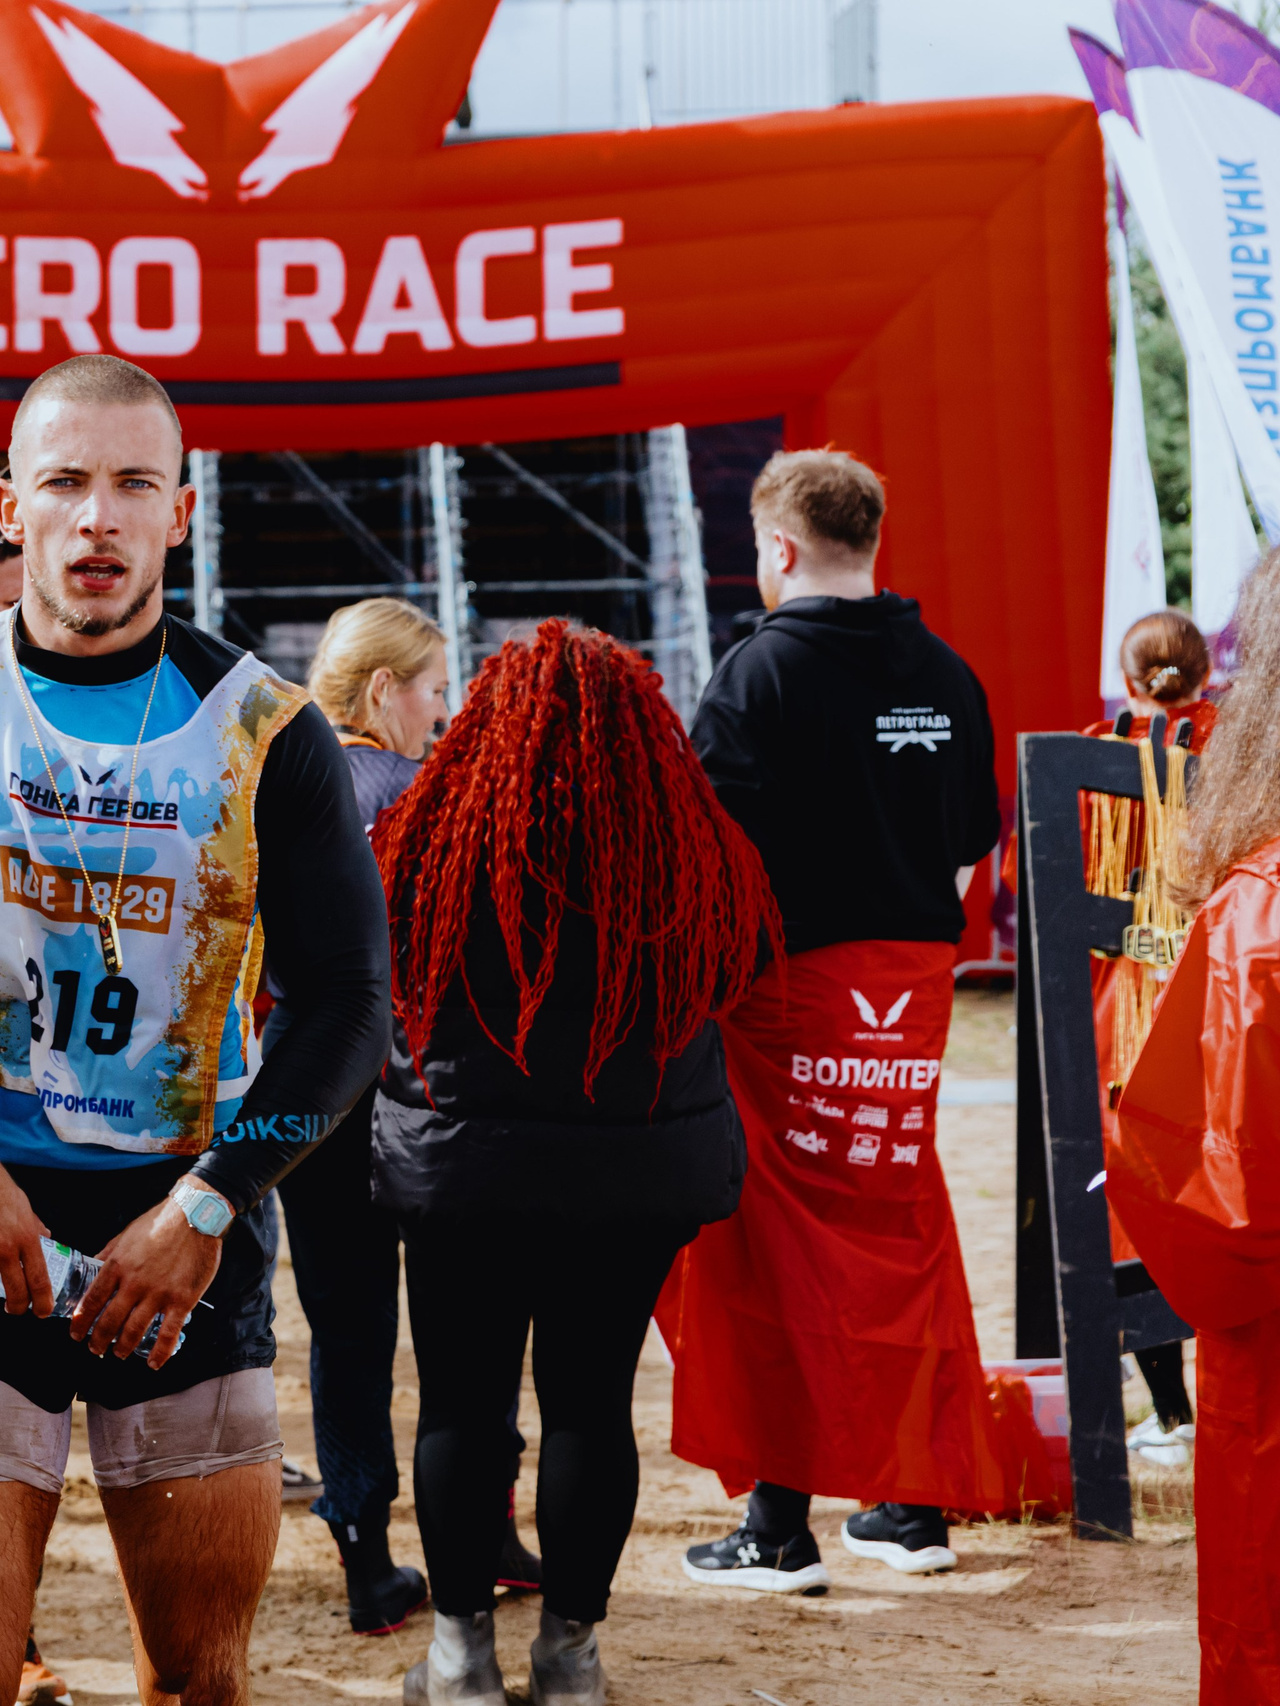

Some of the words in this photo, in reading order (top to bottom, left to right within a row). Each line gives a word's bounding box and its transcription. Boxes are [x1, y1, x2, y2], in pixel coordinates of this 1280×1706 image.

[256, 217, 624, 356] RACE
[9, 771, 80, 813] ГОНКА
[87, 796, 178, 821] ГЕРОЕВ
[8, 856, 56, 912] AGE
[792, 1054, 940, 1090] ВОЛОНТЕР
[35, 1086, 135, 1119] ПРОМБАНК
